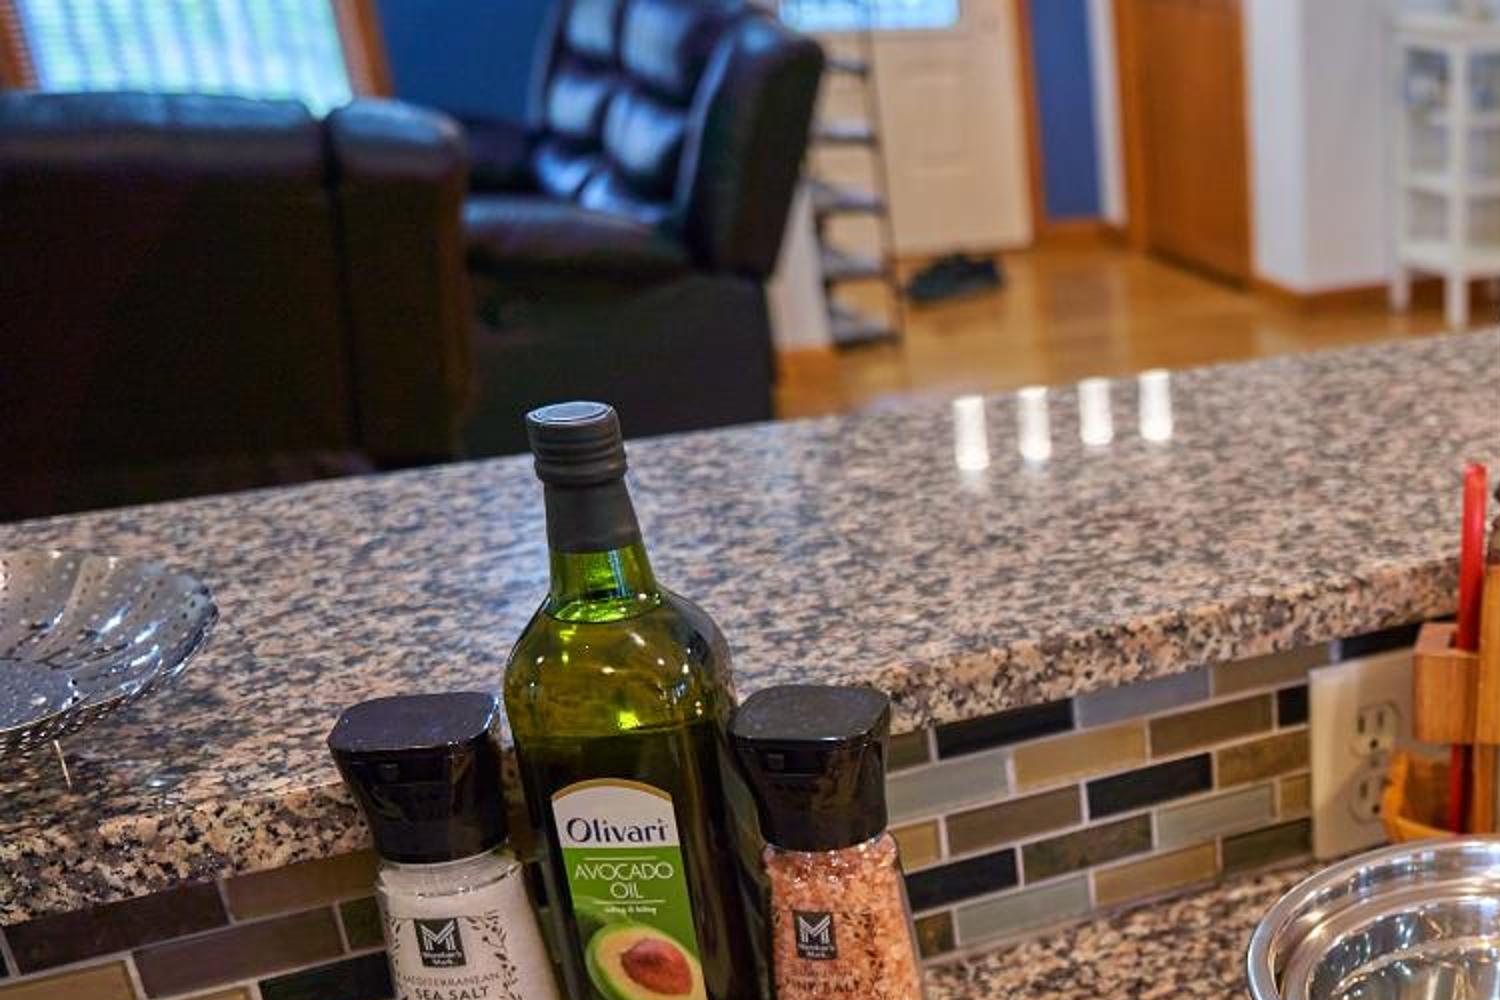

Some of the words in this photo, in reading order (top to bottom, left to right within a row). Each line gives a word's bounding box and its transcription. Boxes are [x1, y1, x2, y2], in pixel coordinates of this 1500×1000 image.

[566, 817, 667, 843] Olivari
[574, 861, 674, 881] AVOCADO
[609, 881, 645, 899] OIL
